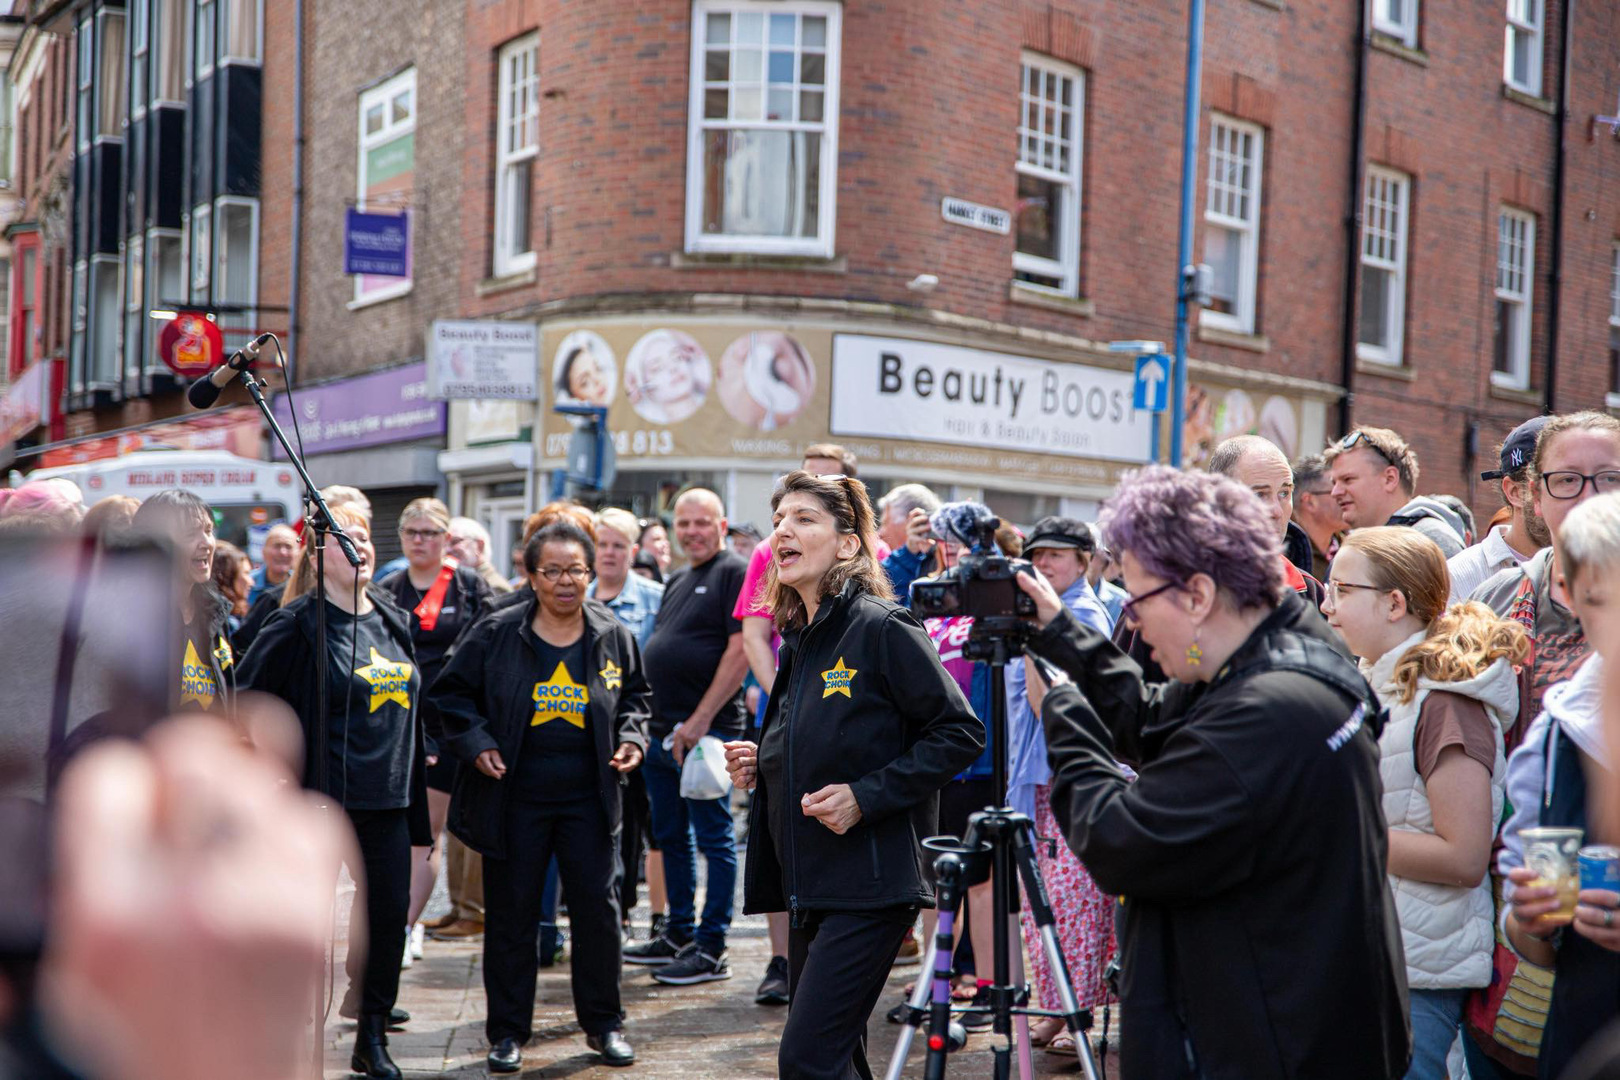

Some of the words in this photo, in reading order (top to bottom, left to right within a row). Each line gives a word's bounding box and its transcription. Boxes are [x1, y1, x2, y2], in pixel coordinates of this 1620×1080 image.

[879, 353, 1025, 419] Beauty
[944, 417, 974, 435] Hair
[980, 418, 991, 436] &
[998, 420, 1049, 444] Beauty
[1052, 426, 1091, 448] Salon
[633, 430, 674, 455] 813
[369, 666, 405, 680] ROCK
[826, 670, 850, 680] ROCK
[369, 680, 409, 696] CHOIR
[536, 684, 584, 700] ROCK
[824, 679, 851, 689] CHOIR
[534, 699, 587, 716] CHOIR
